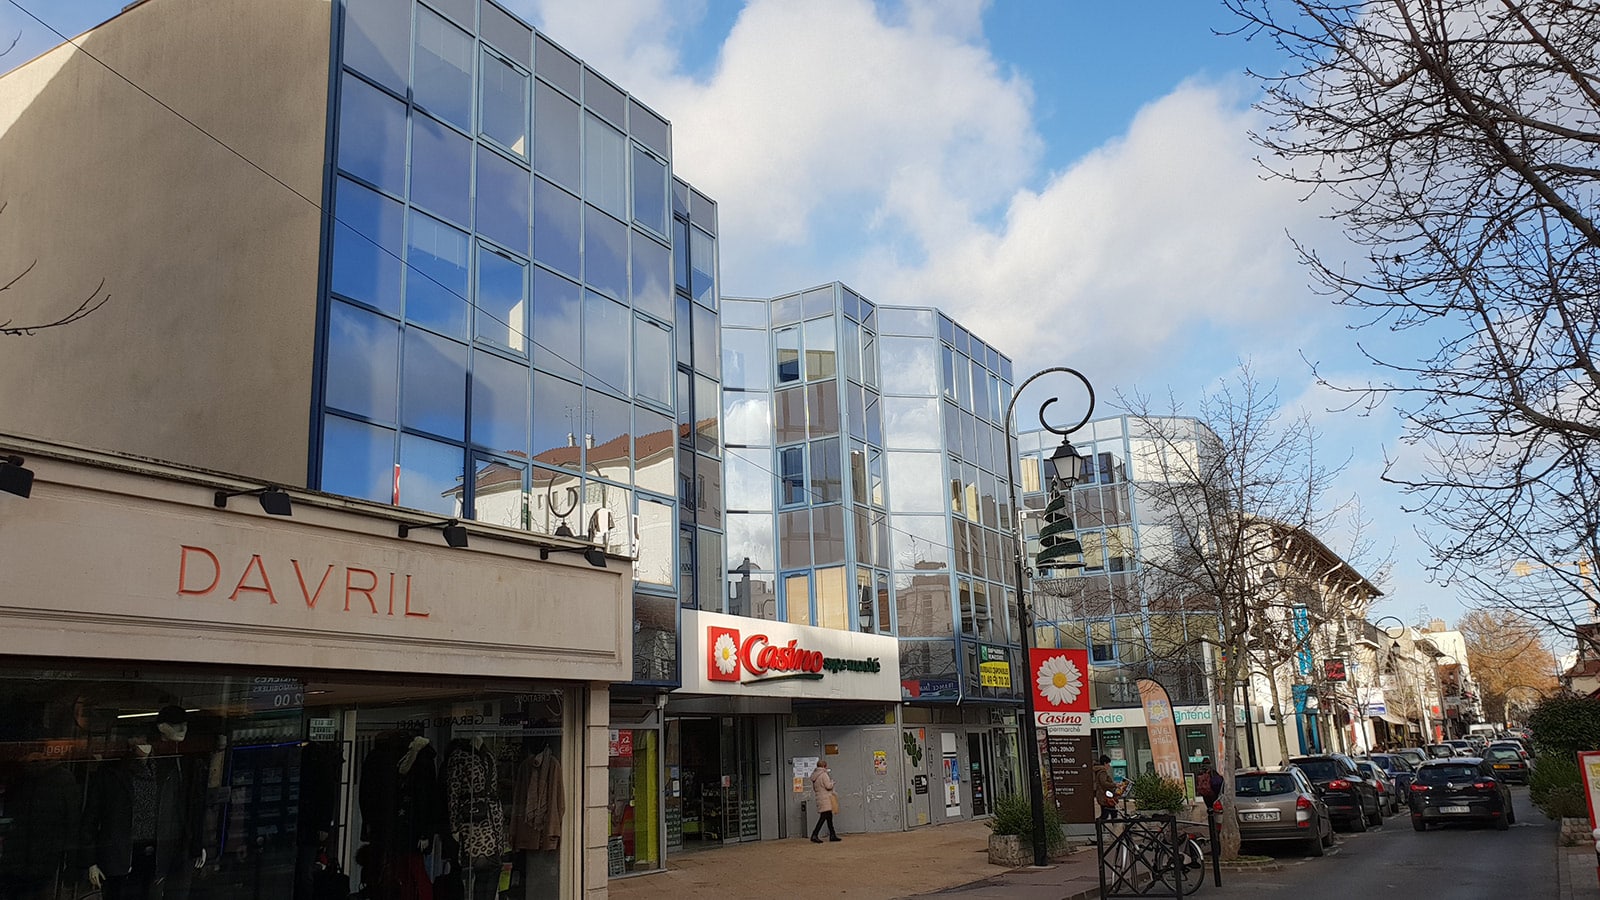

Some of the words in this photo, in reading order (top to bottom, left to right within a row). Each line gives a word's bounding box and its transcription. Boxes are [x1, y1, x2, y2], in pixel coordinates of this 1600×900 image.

[177, 544, 430, 618] DAVRIL
[741, 634, 824, 676] Casino
[1038, 712, 1082, 725] Casino
[1090, 713, 1124, 724] endre
[1175, 709, 1211, 725] entend
